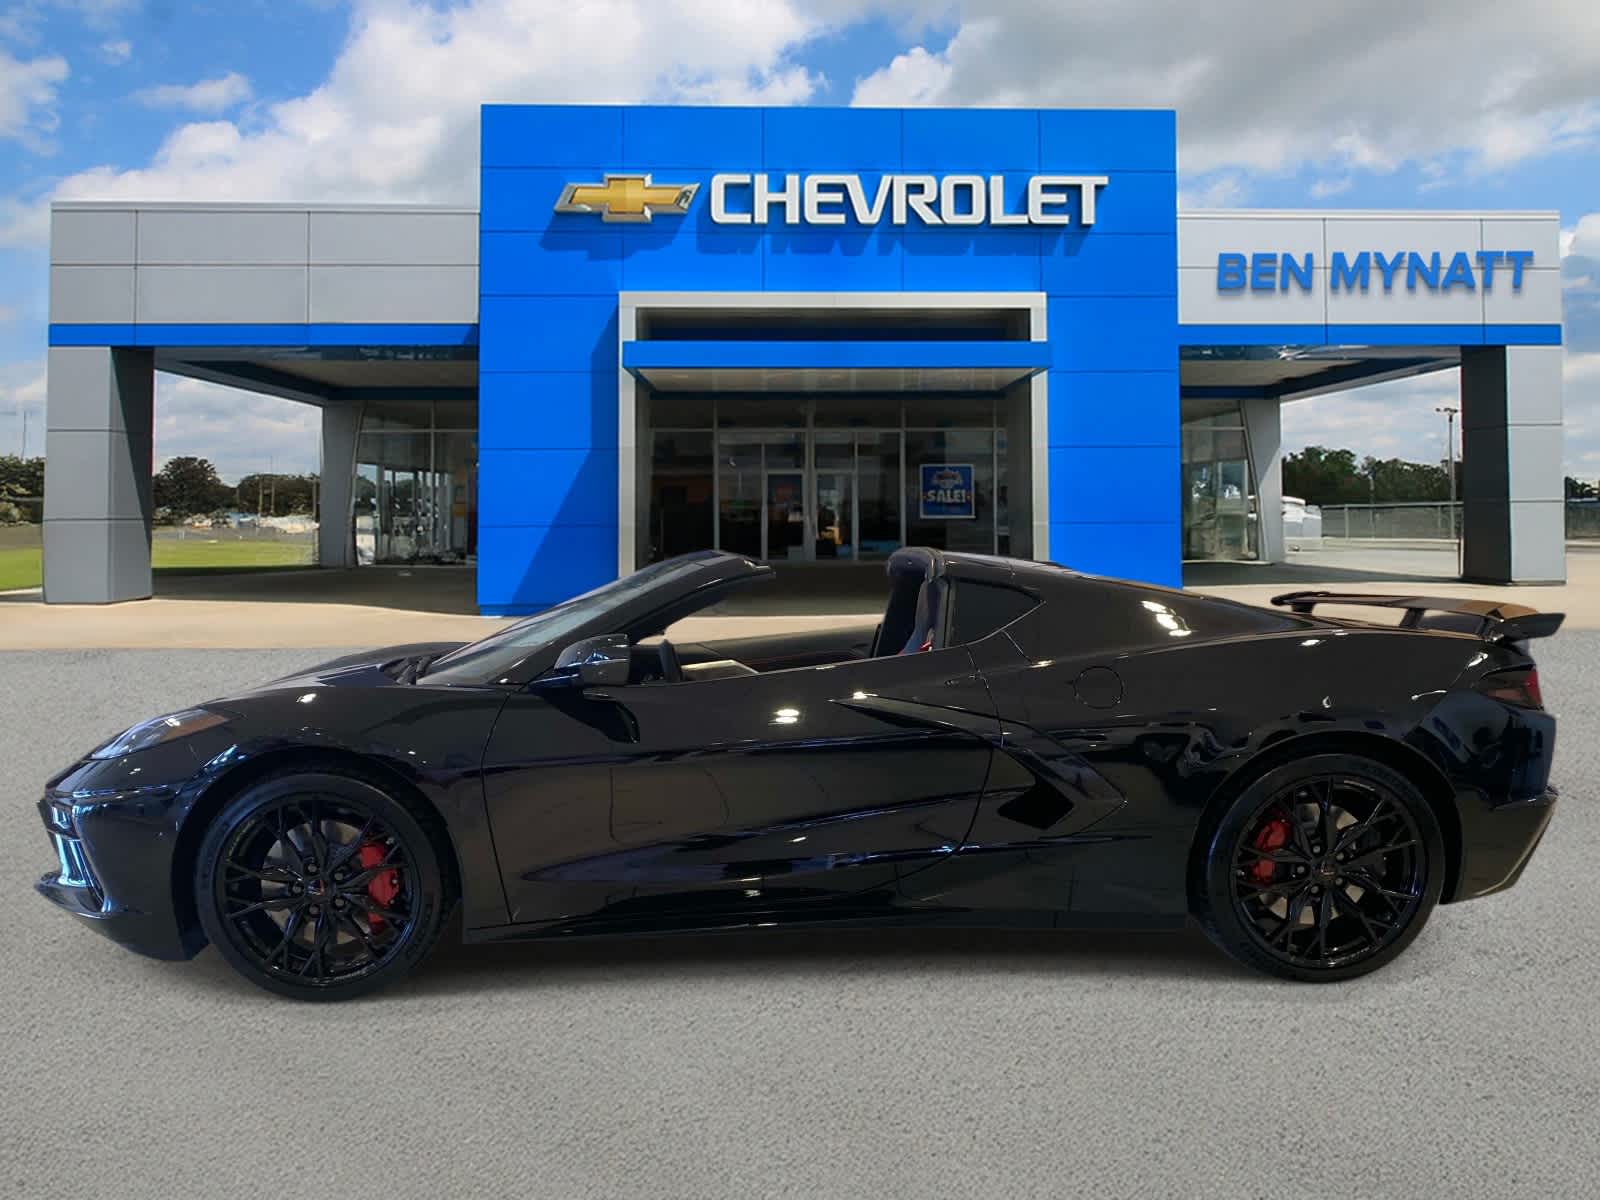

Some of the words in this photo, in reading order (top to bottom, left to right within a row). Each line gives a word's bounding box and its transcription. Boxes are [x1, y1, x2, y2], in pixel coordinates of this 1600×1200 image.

[711, 174, 1109, 224] CHEVROLET
[1218, 252, 1313, 290] BEN
[1331, 251, 1533, 290] MYNATT
